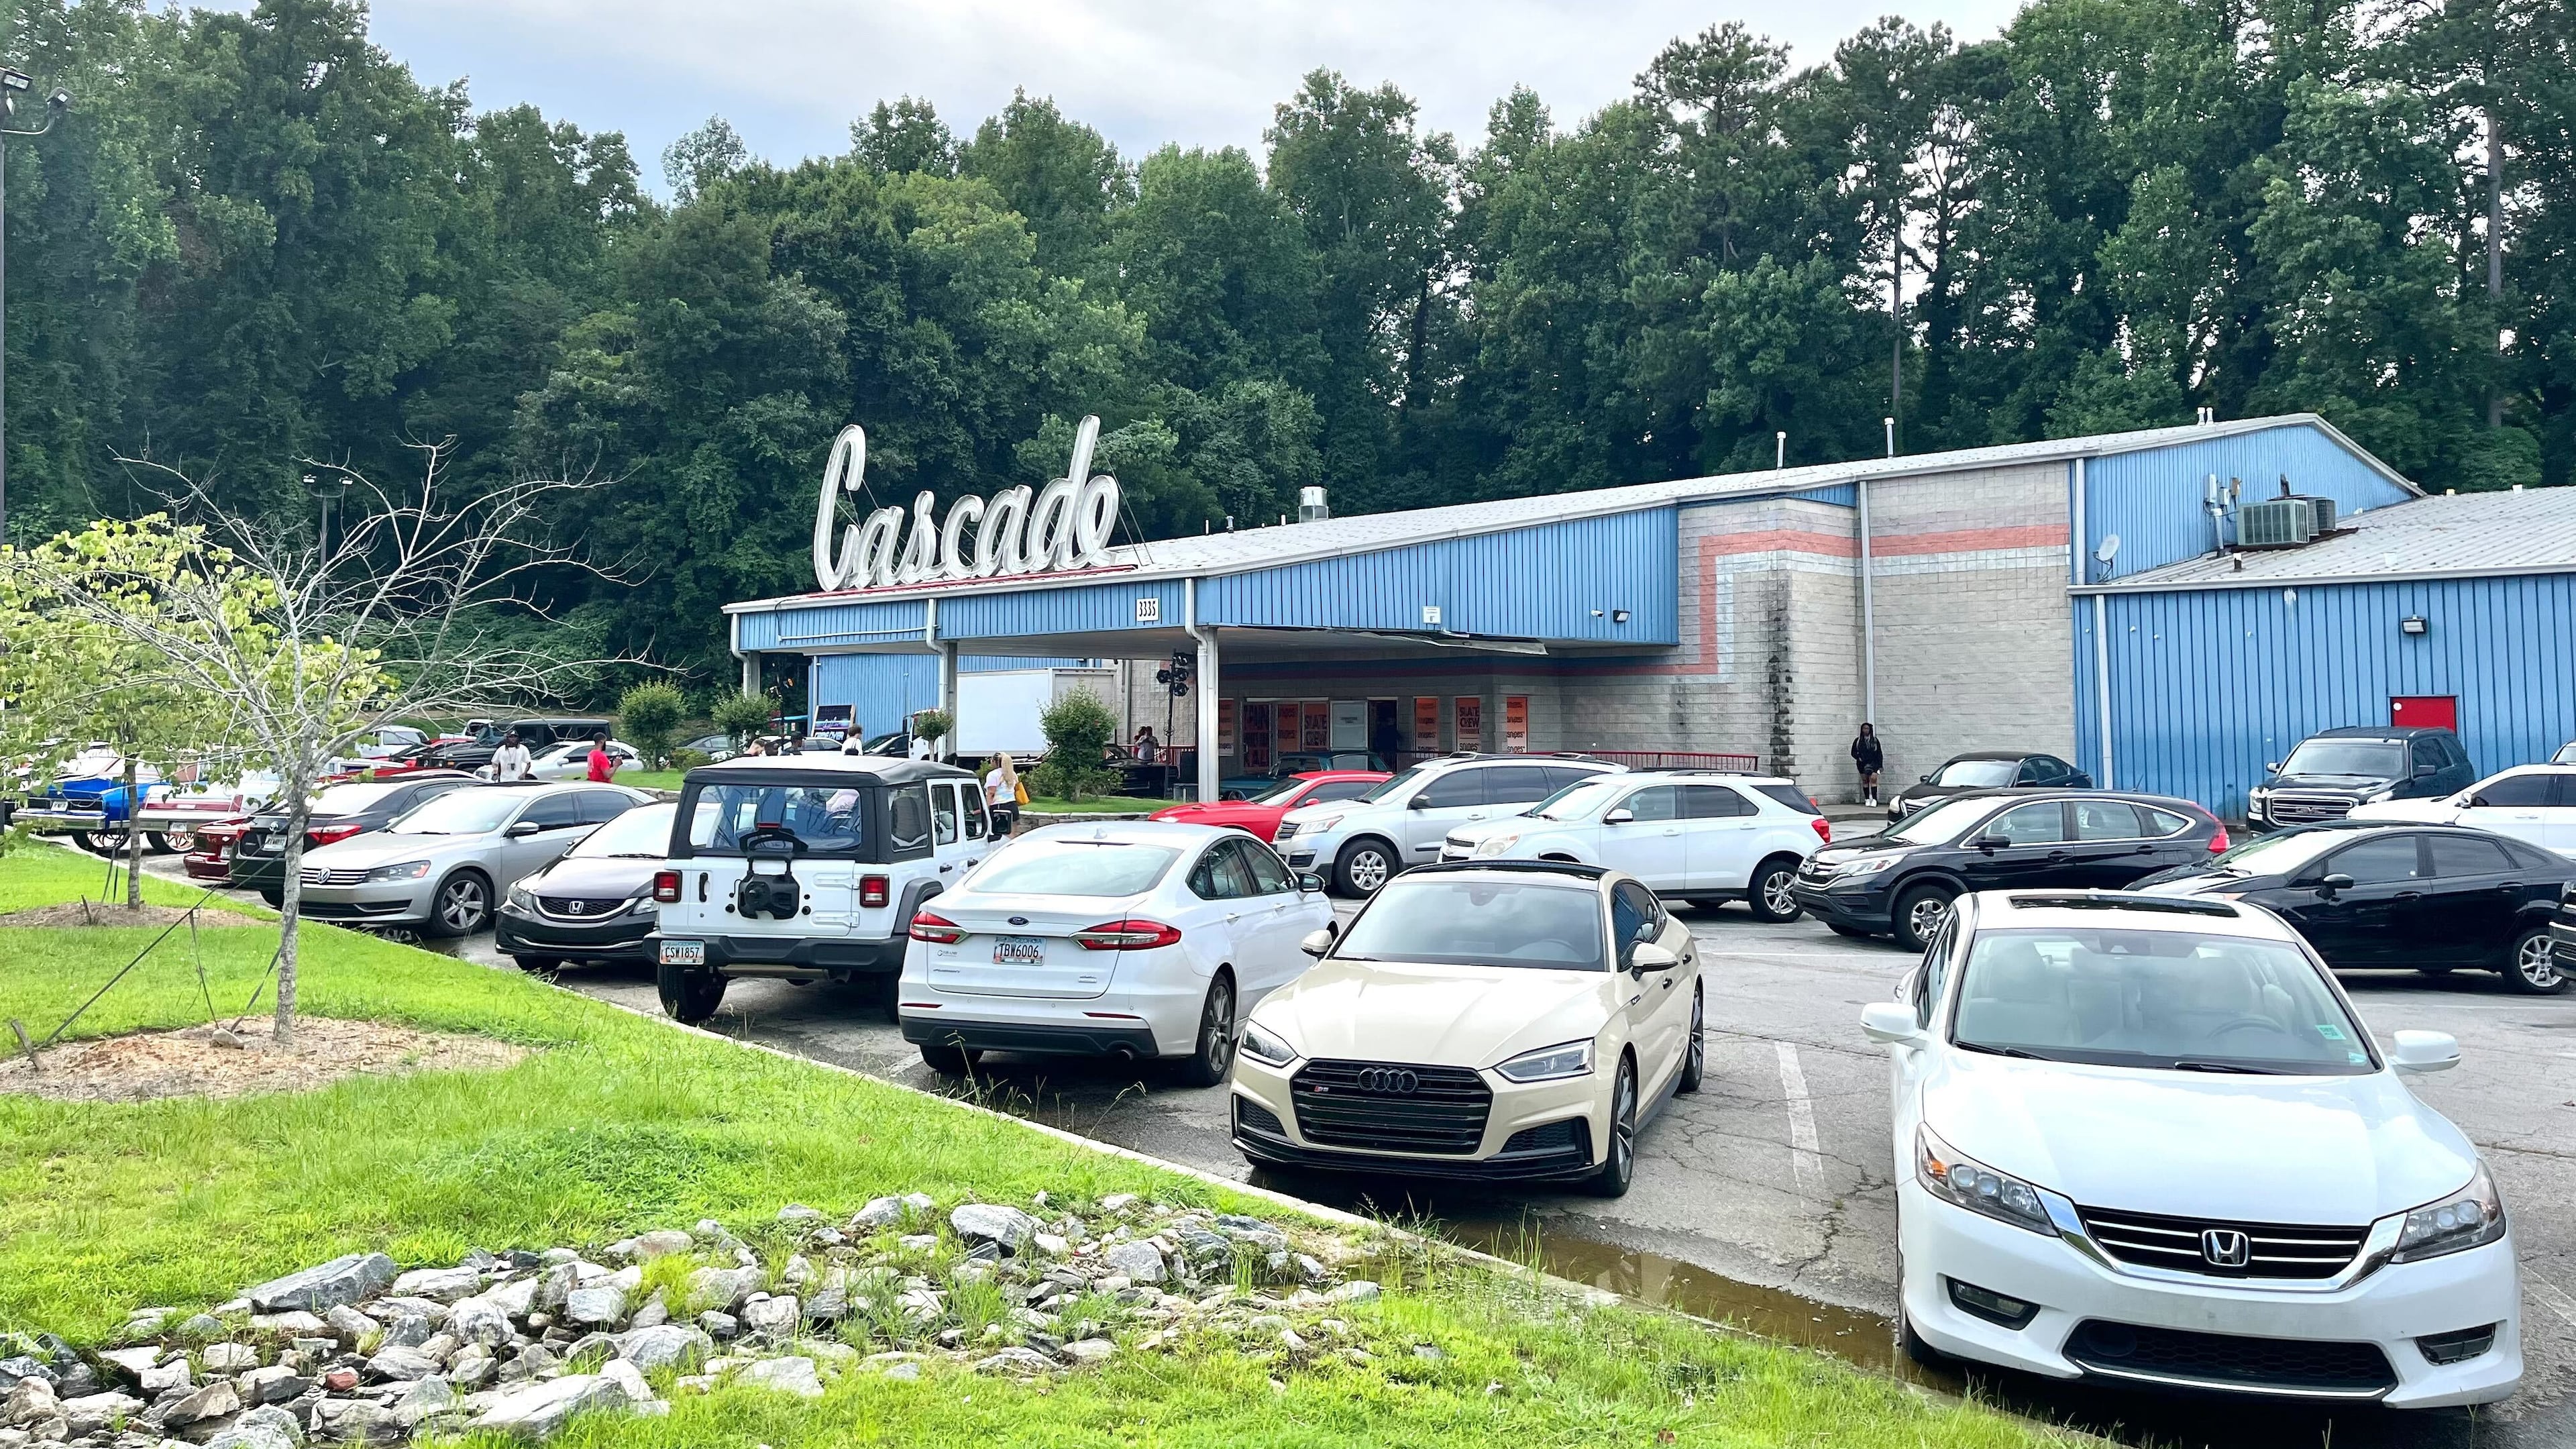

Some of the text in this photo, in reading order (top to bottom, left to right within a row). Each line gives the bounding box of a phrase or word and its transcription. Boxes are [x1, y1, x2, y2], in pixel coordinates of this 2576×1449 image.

[814, 414, 1119, 592] Cascade
[1139, 600, 1156, 617] 3335
[665, 947, 700, 959] CSW1857
[999, 943, 1039, 958] TBW6006
